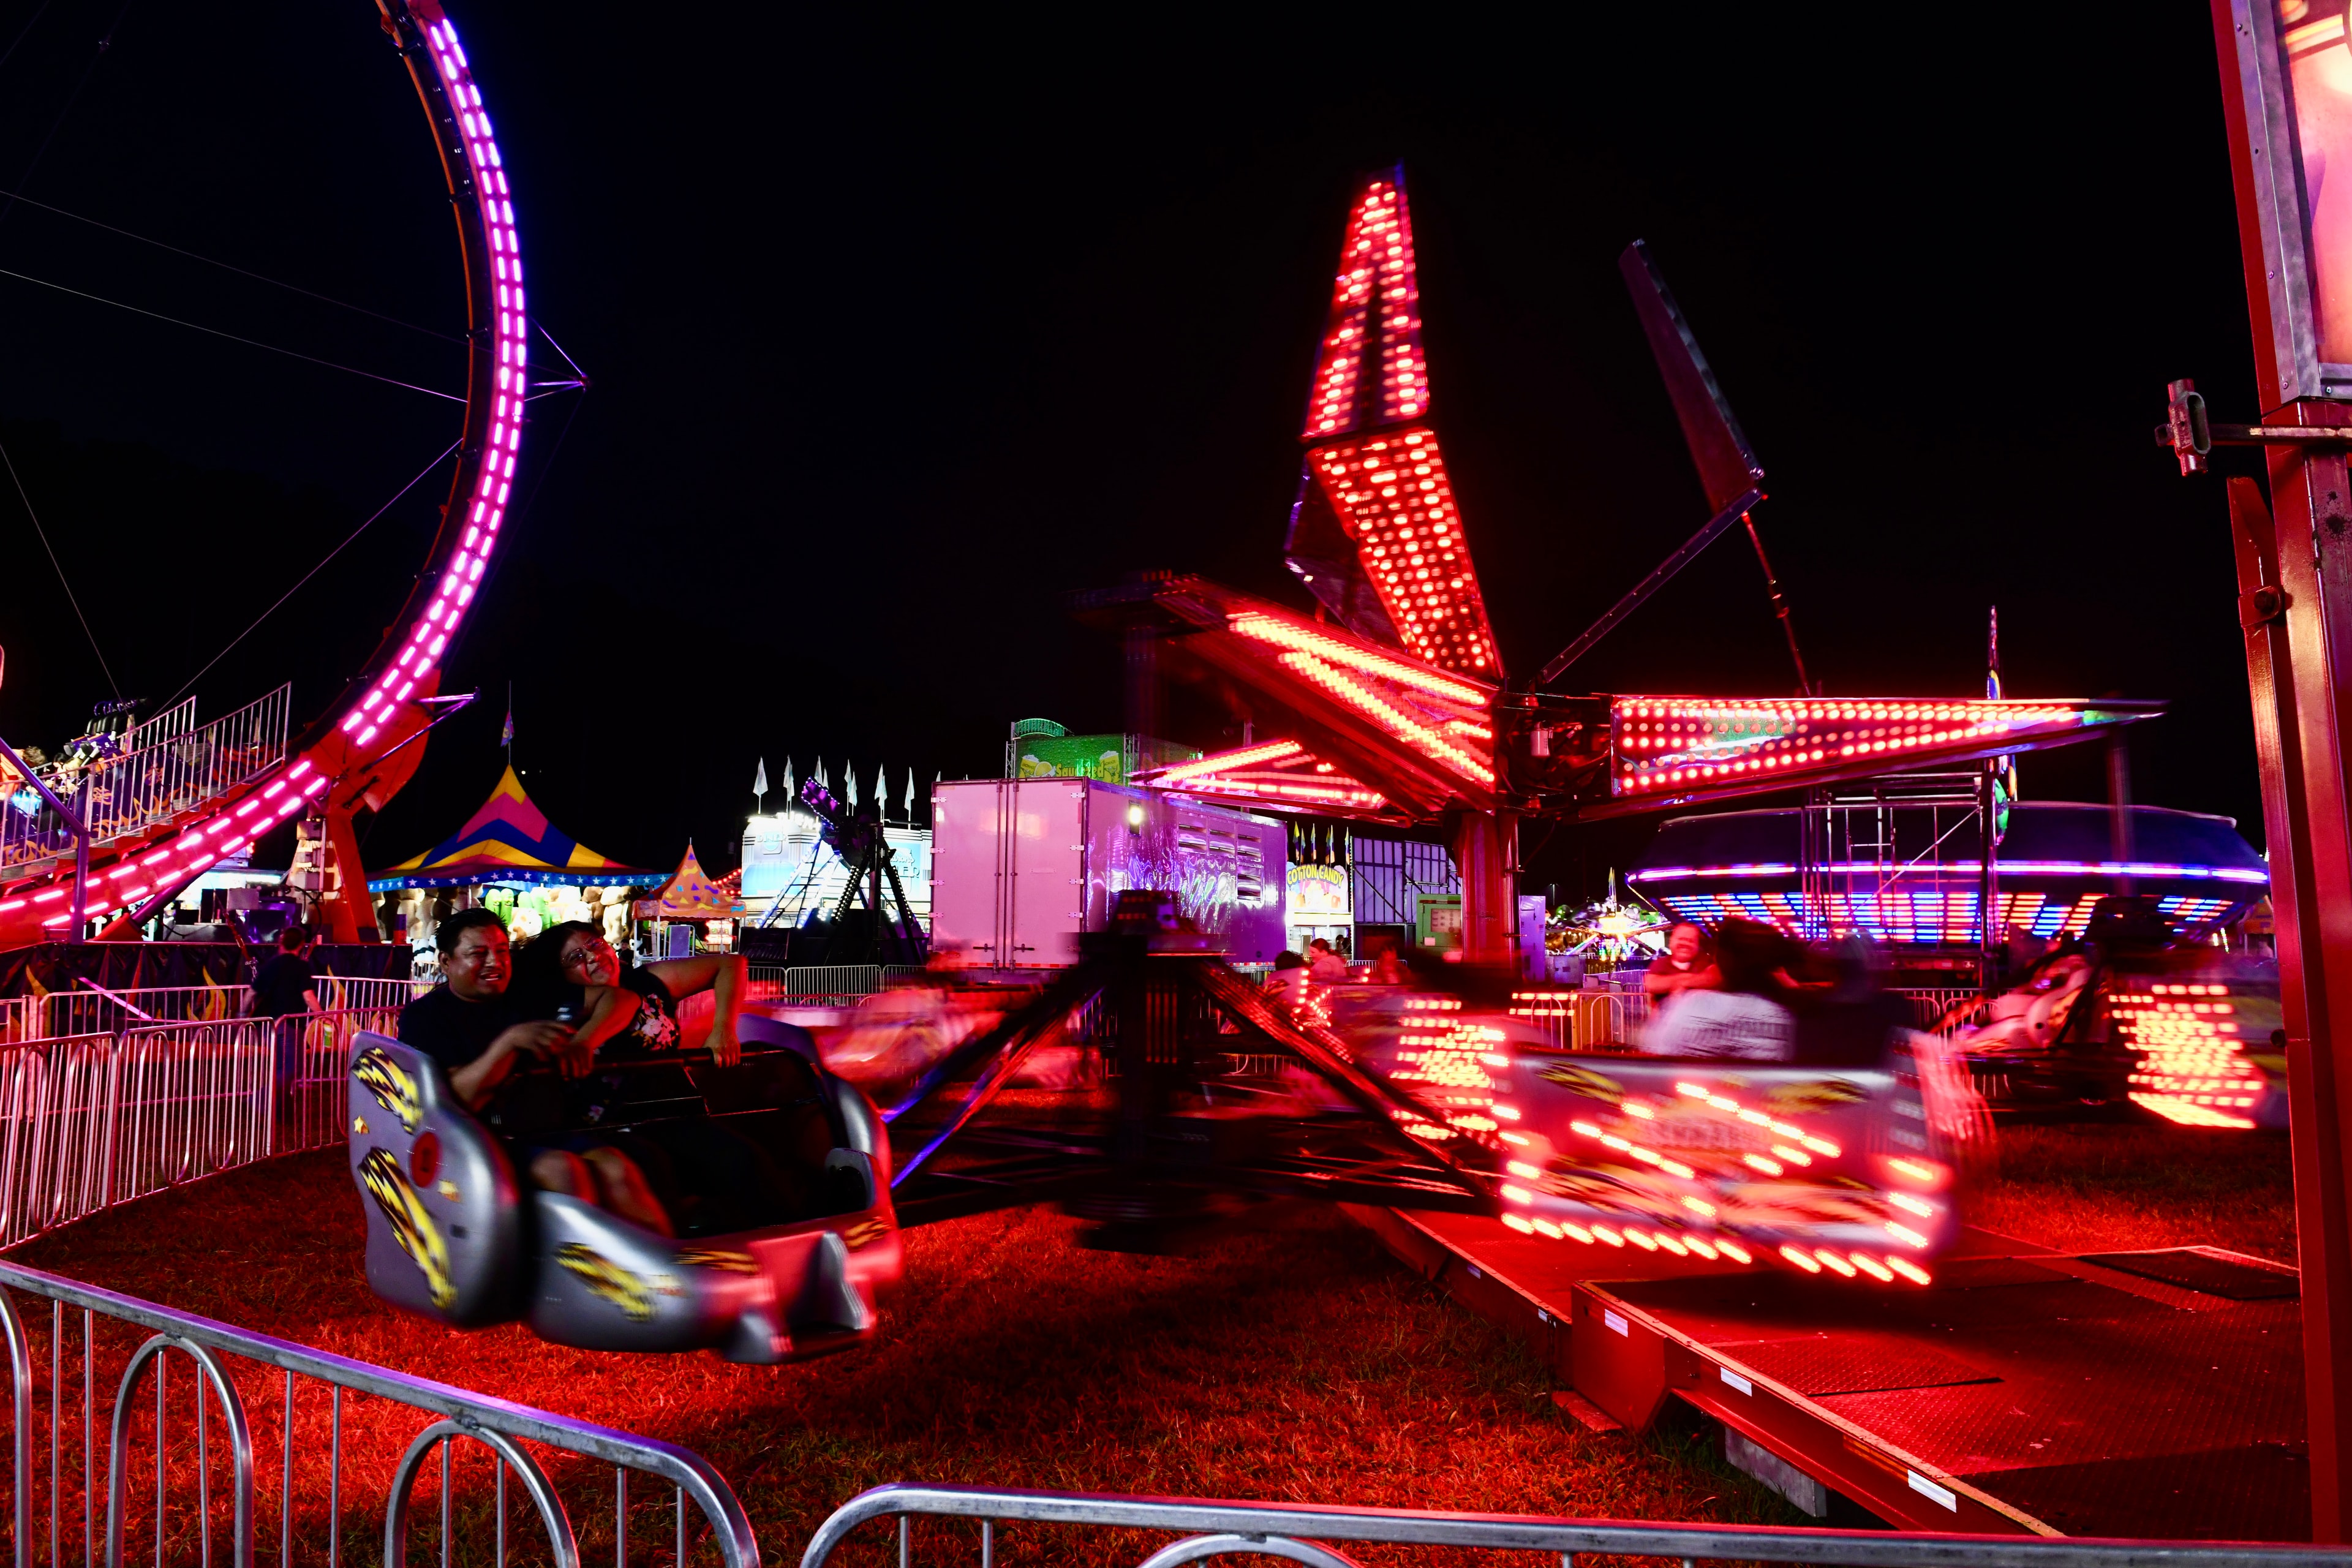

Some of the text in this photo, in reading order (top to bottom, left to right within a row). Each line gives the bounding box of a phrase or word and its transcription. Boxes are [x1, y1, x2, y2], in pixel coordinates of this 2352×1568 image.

[756, 834, 787, 843] DINER
[1287, 865, 1344, 887] COTTON CANDY
